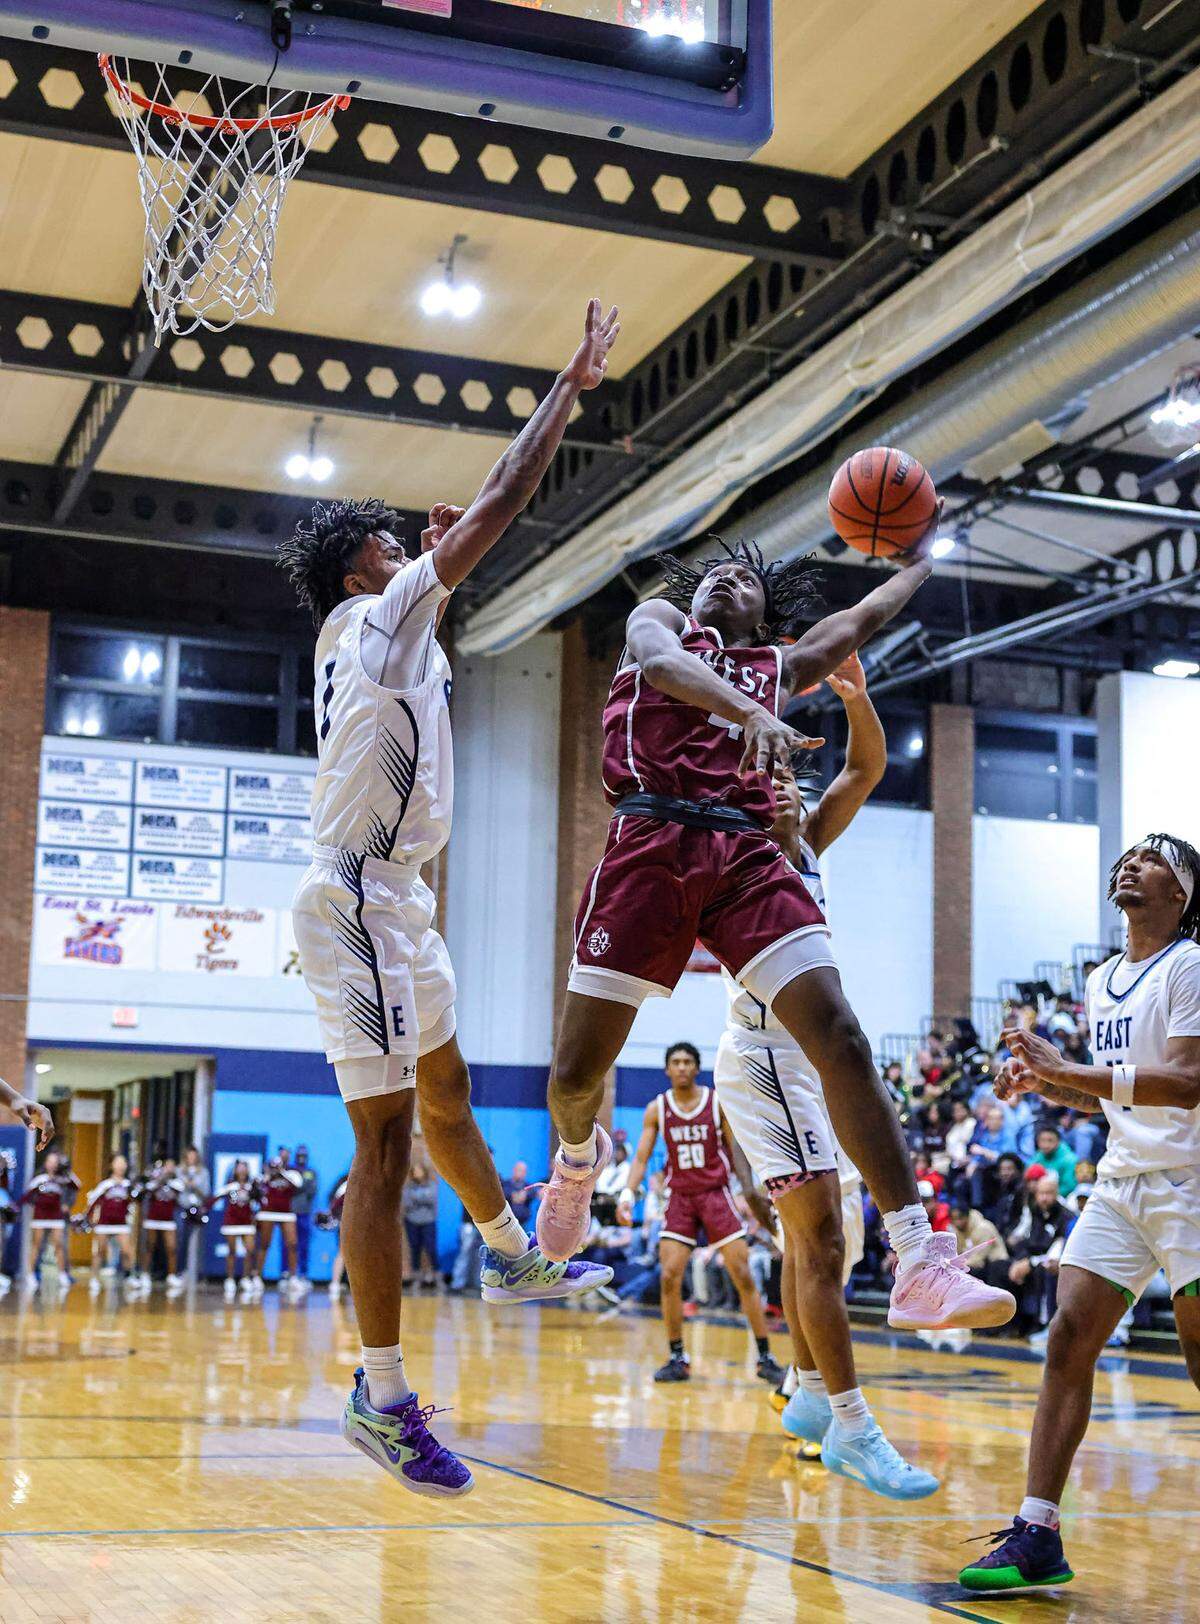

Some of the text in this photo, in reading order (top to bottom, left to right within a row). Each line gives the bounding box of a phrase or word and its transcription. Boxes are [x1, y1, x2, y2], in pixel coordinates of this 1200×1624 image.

[43, 896, 78, 911] East
[111, 901, 154, 916] Louis
[174, 905, 264, 923] Edwardsville
[196, 955, 239, 973] Tigers
[391, 1005, 405, 1036] E
[1096, 1016, 1132, 1051] EAST
[669, 1124, 709, 1142] WEST
[803, 1130, 819, 1155] E
[677, 1143, 705, 1170] 20
